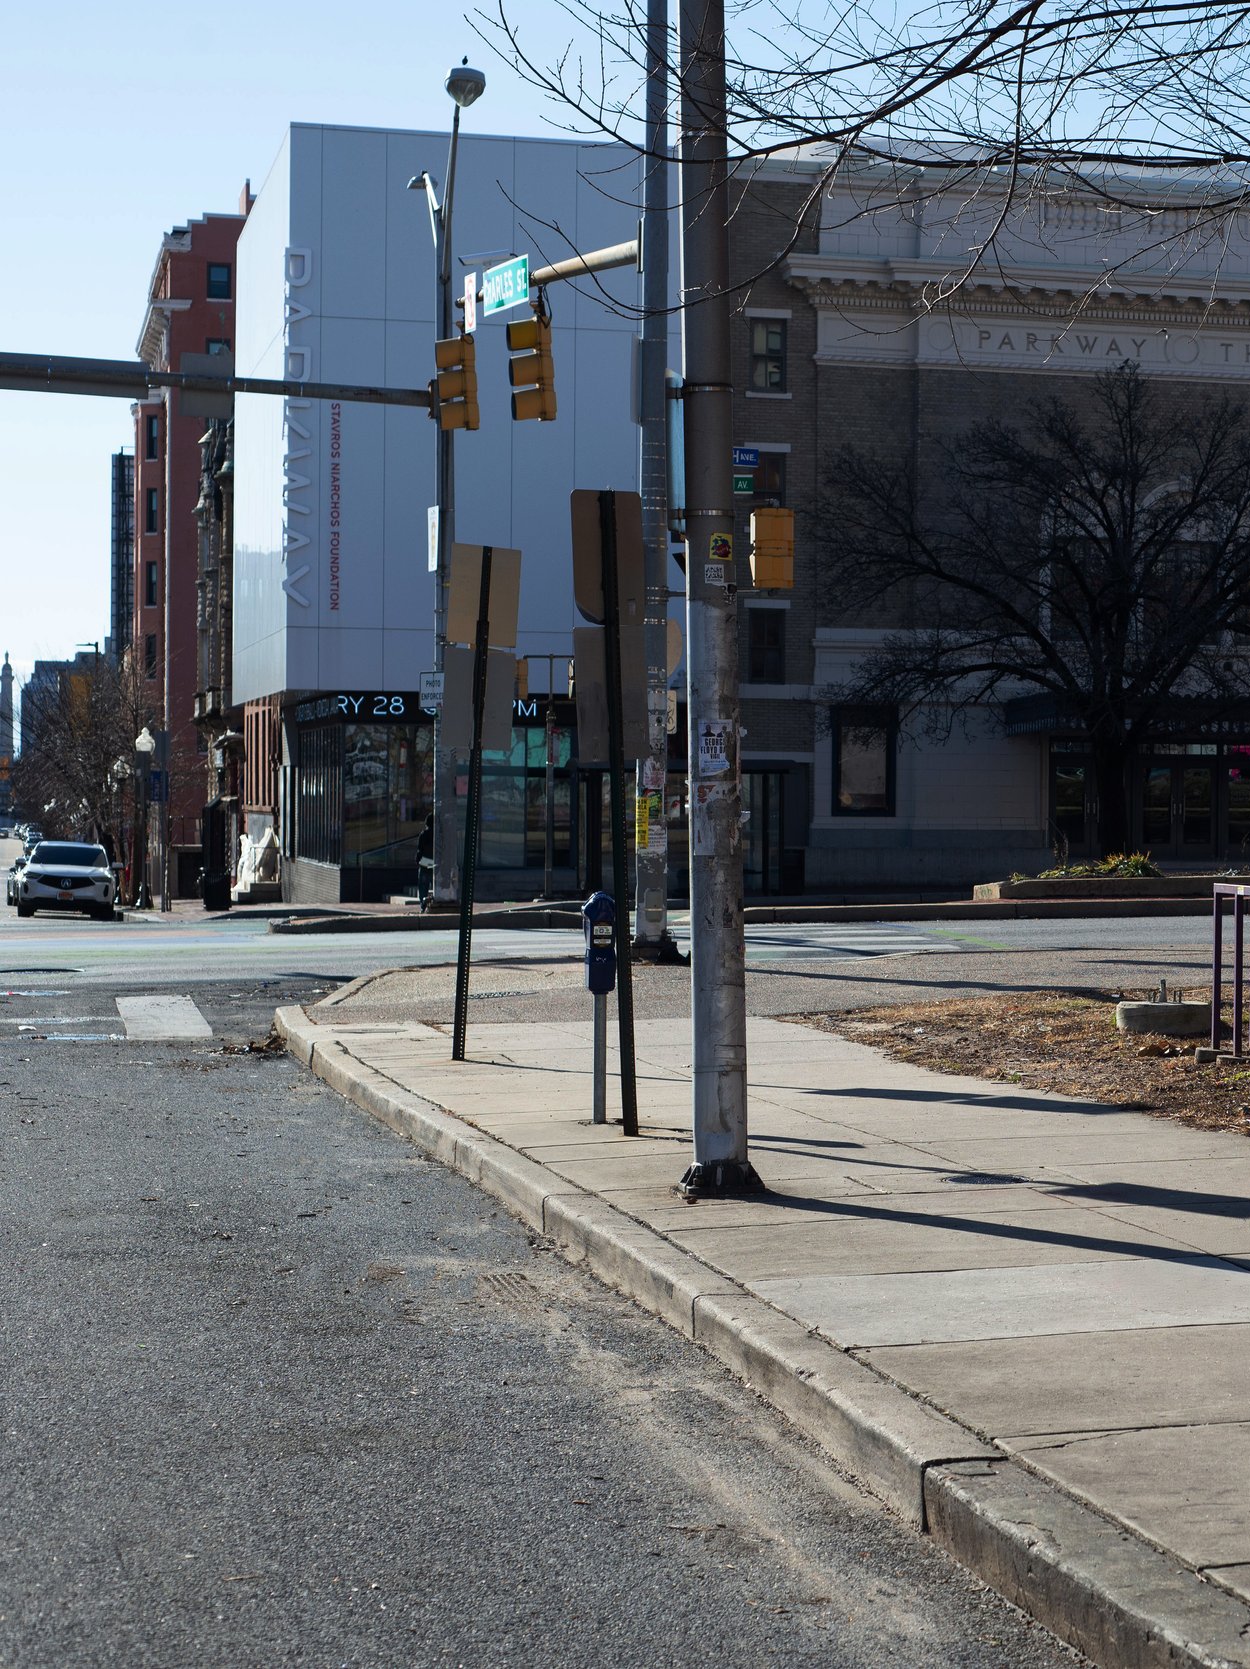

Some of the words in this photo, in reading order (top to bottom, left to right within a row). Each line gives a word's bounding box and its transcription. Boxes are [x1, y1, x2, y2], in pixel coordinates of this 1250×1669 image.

[516, 268, 527, 292] ST.
[977, 329, 1147, 358] PARKWAY
[331, 402, 341, 459] STAVROS
[331, 462, 340, 528] NIARCHOS
[330, 531, 340, 611] FOUNDATION
[426, 679, 441, 689] PHOTO
[373, 695, 405, 715] 28
[421, 692, 444, 701] ENFORCE
[700, 745, 718, 754] FLOYD
